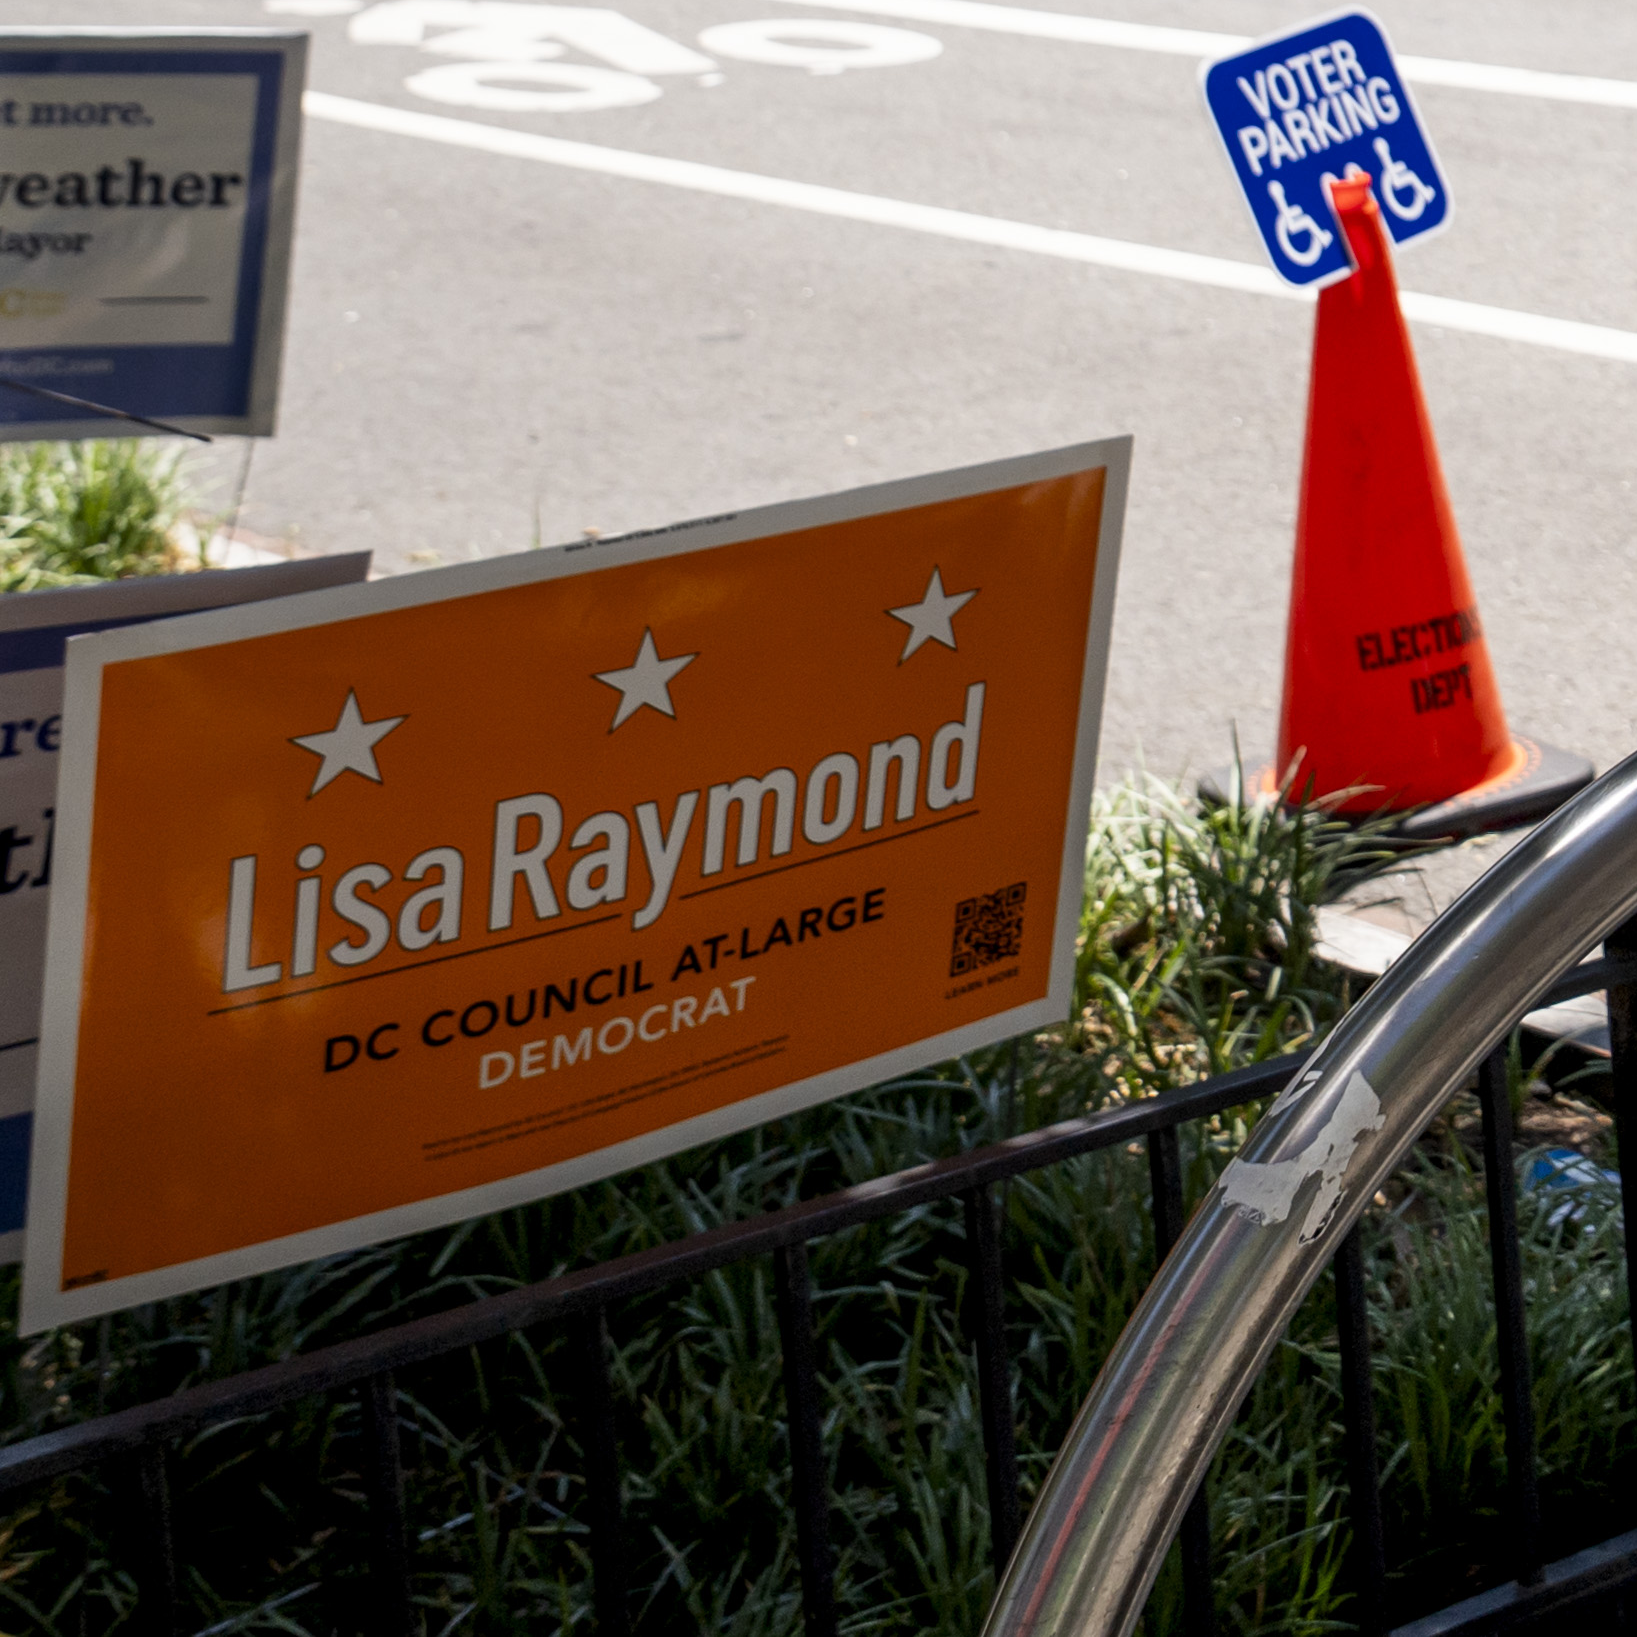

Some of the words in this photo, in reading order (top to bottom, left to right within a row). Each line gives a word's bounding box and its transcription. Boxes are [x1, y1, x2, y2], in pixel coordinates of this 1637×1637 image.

[1237, 39, 1367, 121] VOTER
[1238, 76, 1401, 177] PARKING
[0, 225, 93, 259] ayor
[222, 843, 465, 995] Lisa
[487, 679, 987, 933] Raymond
[323, 1022, 400, 1074] DC
[421, 959, 653, 1048] COUNCIL
[670, 887, 887, 982] AT-LARGE
[478, 975, 758, 1091] DEMOCRAT
